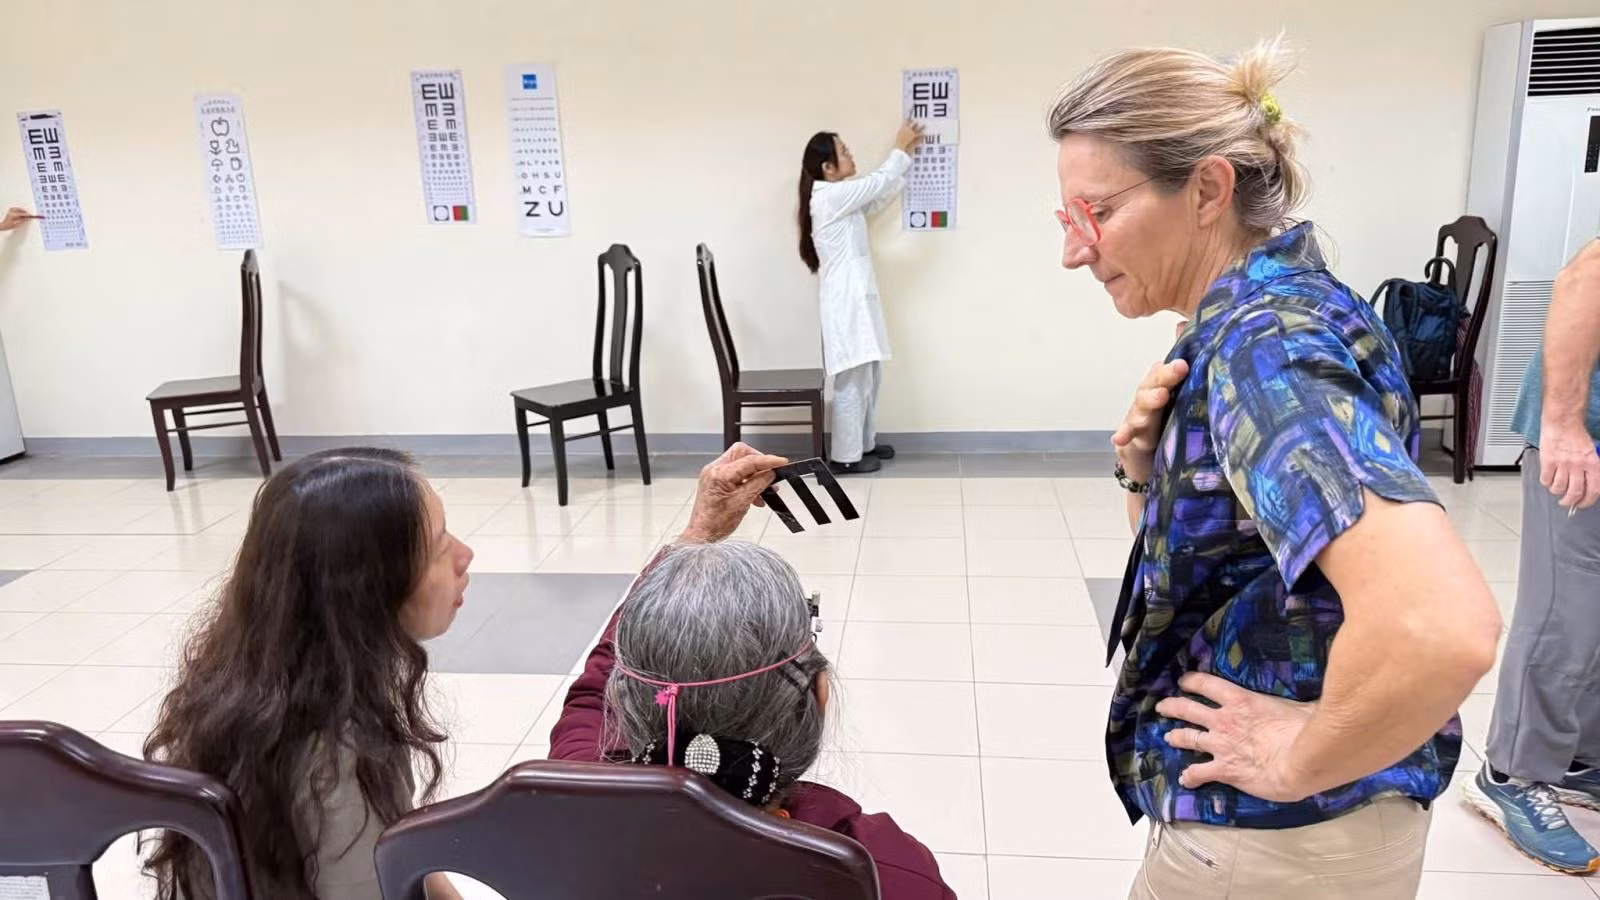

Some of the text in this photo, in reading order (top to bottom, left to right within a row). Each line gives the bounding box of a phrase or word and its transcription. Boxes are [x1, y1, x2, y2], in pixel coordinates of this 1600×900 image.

[522, 185, 561, 195] M C F
[524, 200, 564, 217] Z U
